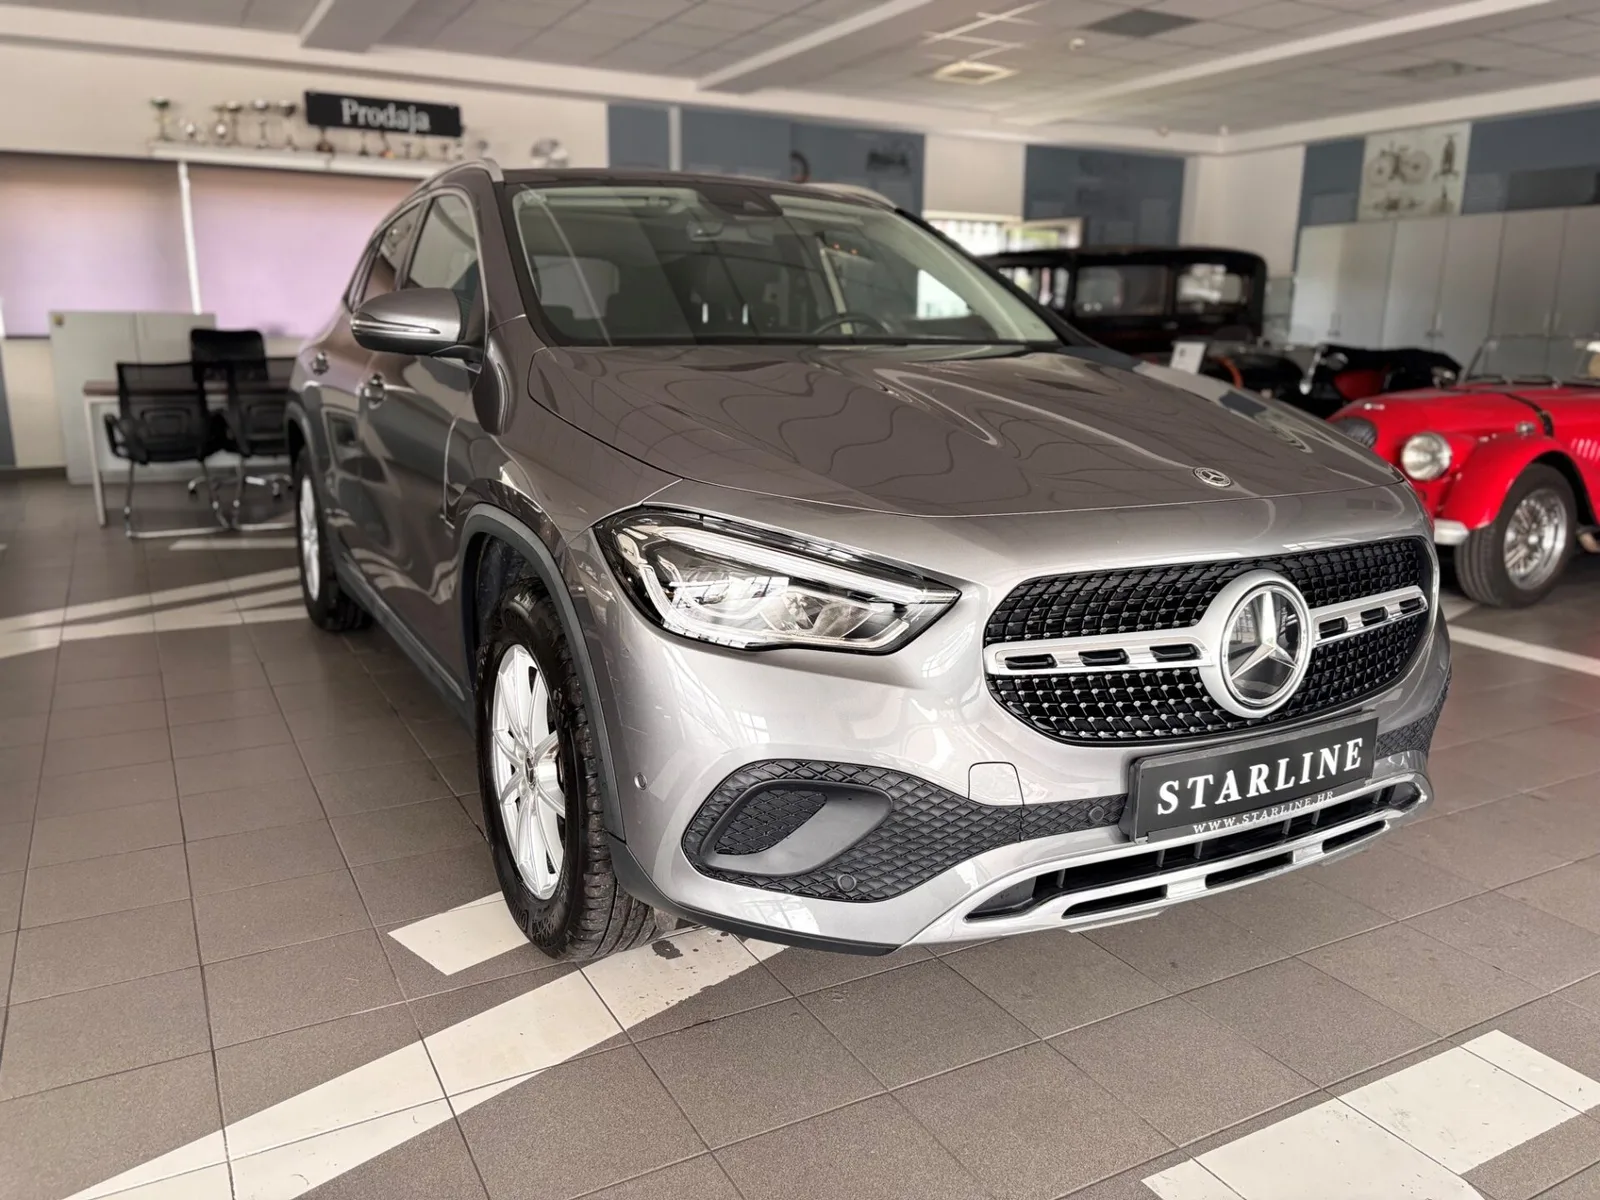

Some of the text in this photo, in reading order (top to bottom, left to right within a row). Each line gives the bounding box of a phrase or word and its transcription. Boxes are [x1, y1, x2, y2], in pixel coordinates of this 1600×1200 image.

[340, 97, 431, 134] Prodaja
[1157, 737, 1363, 815] STARLINE
[1192, 790, 1334, 835] WWW.STARLINE.HR
